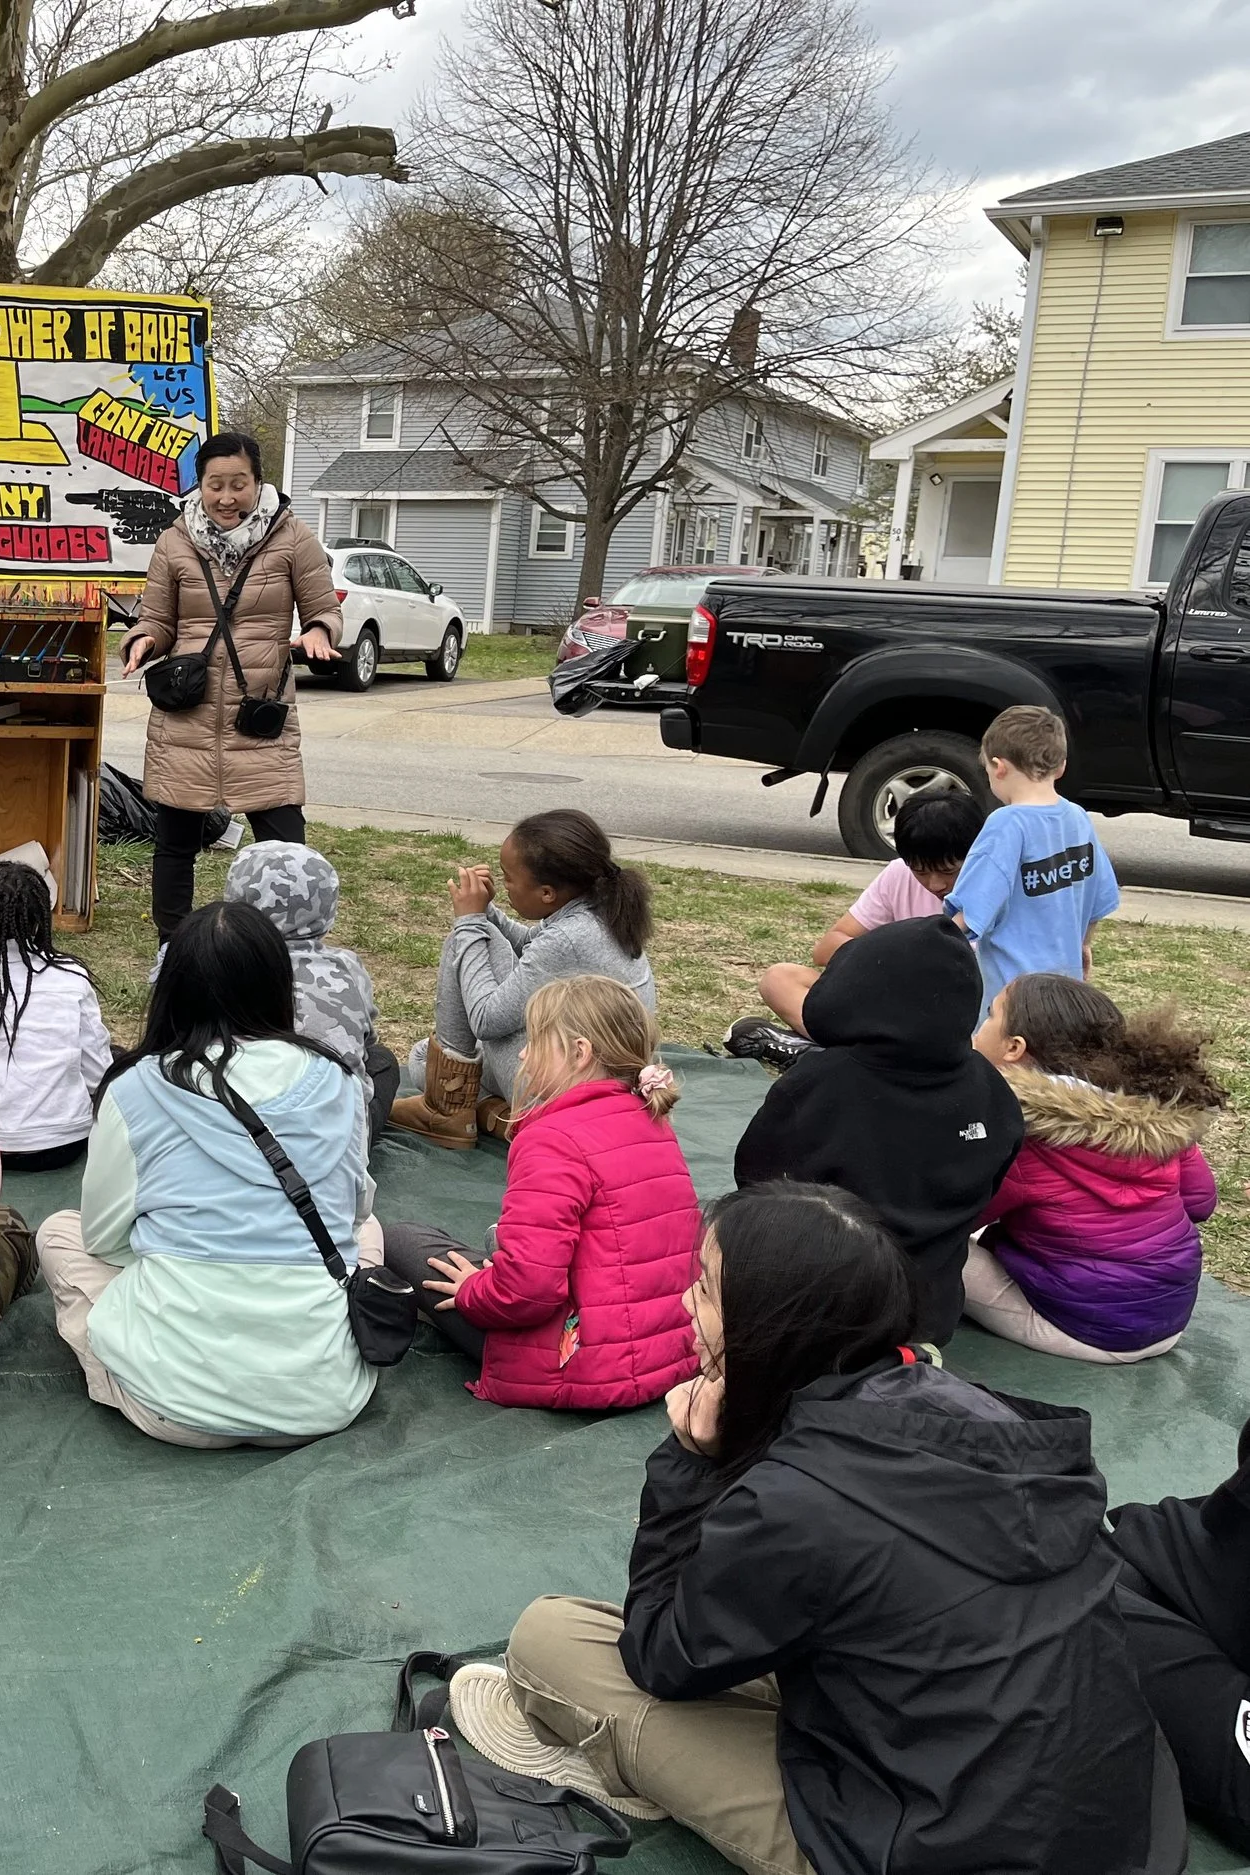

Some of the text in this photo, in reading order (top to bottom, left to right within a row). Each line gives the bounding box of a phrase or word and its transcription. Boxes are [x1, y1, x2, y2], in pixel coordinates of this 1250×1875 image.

[84, 311, 116, 360] OF
[153, 367, 187, 382] LET
[165, 387, 195, 404] US
[78, 391, 195, 460] CONFUSE
[79, 419, 180, 495] LANGUAGE
[726, 631, 783, 649] TRD
[783, 641, 825, 649] ROAD
